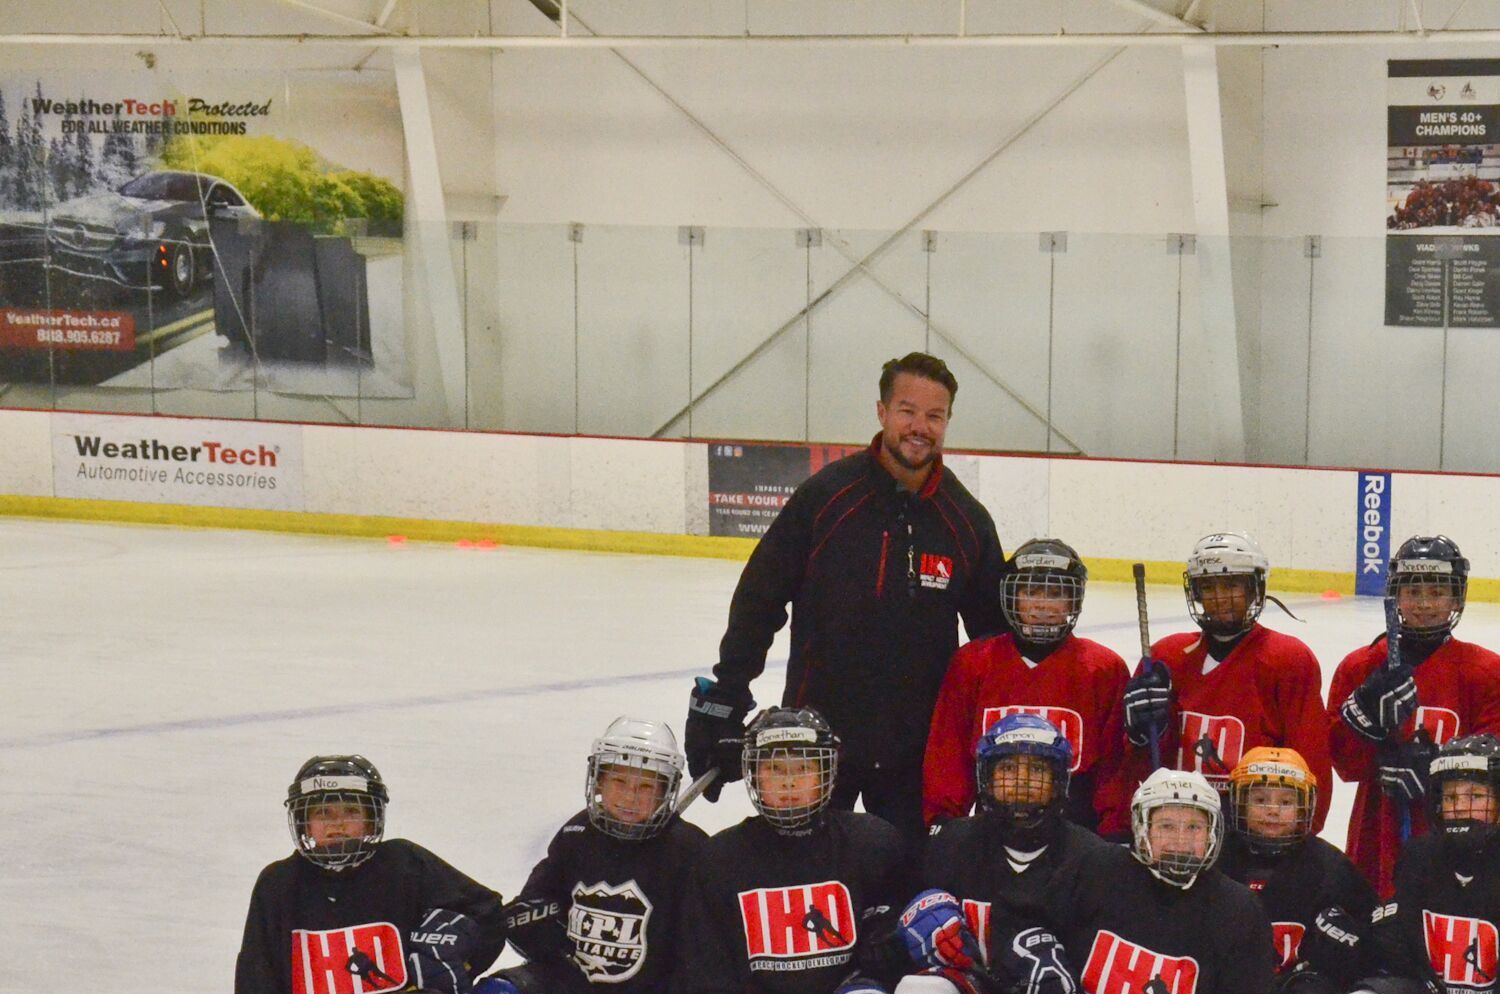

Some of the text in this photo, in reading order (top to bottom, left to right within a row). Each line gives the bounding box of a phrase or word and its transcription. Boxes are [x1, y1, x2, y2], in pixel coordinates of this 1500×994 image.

[31, 98, 272, 117] WeatherTech Protected
[1420, 112, 1482, 123] MEN'S 40+
[61, 120, 247, 136] FOR ALL WEATHER CONDITIONS
[1416, 124, 1486, 136] CHAMPIONS
[75, 436, 277, 467] WeatherTech
[77, 463, 277, 489] Automotive Accessories
[714, 493, 778, 506] TAKE YOUR
[1364, 475, 1385, 574] Reebok
[313, 778, 338, 789] Nico
[737, 879, 857, 960] IHD
[750, 953, 851, 972] MPACT HOCKEY DEVELOPM
